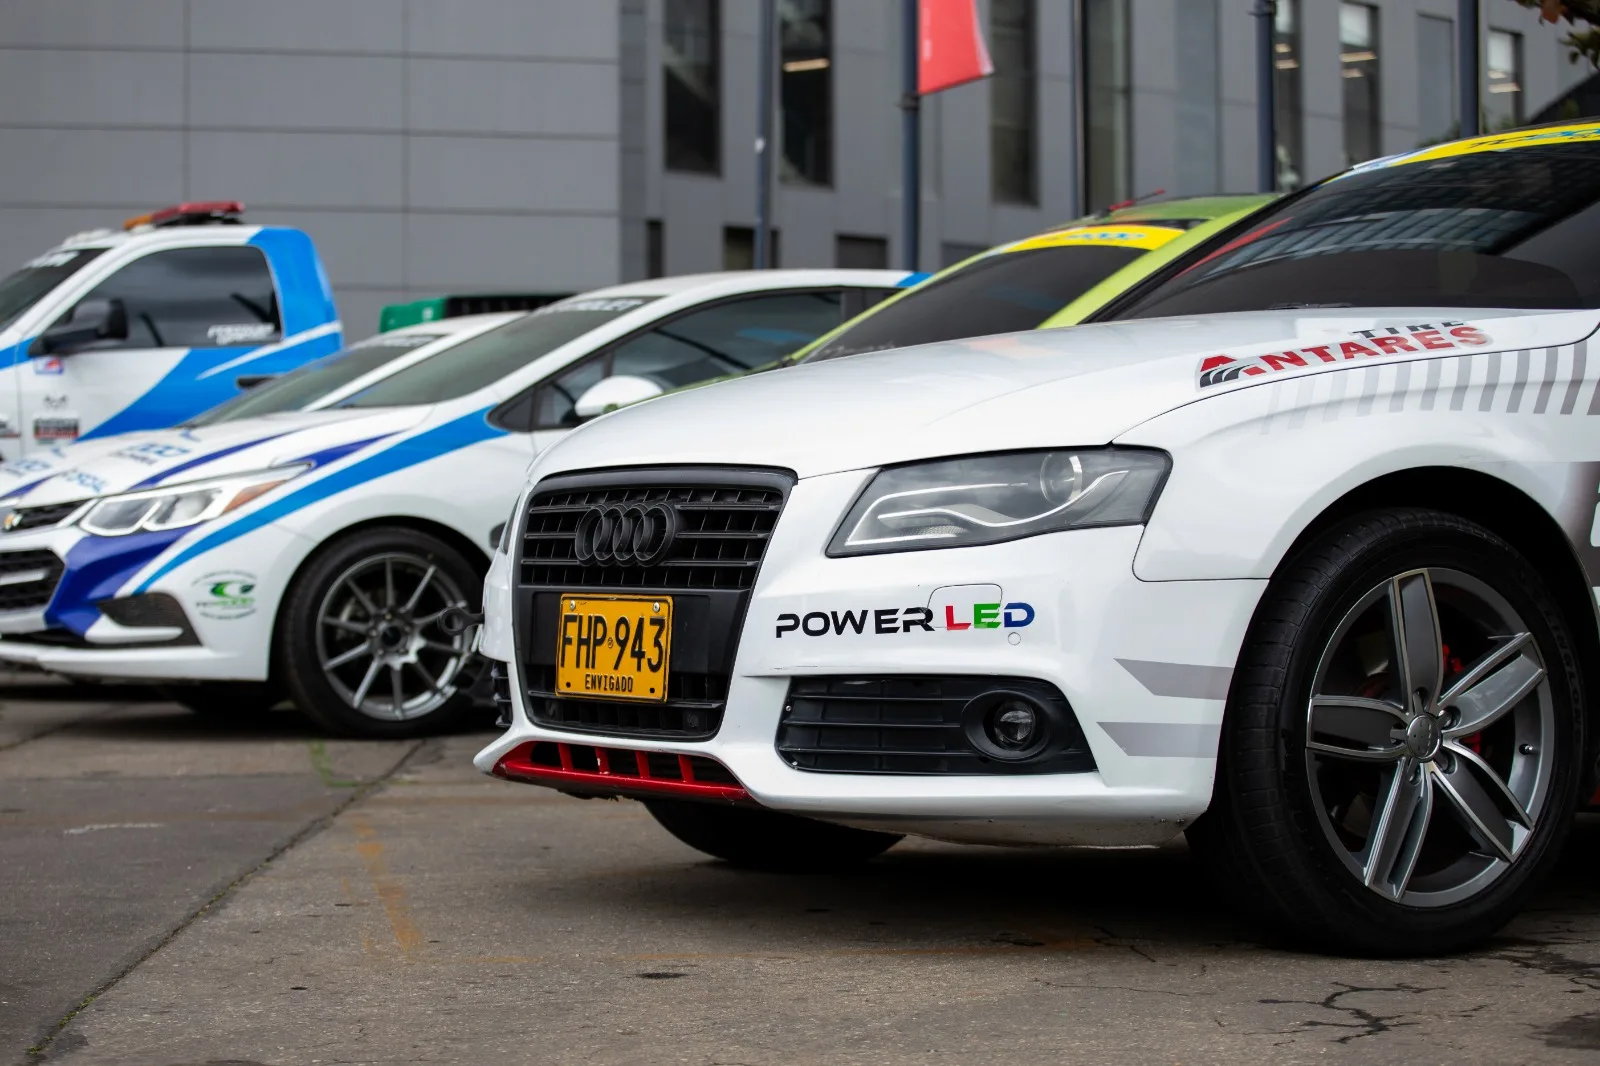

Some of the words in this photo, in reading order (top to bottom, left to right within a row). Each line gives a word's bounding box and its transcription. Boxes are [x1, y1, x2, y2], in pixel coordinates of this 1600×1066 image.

[775, 606, 935, 638] POWER
[945, 602, 1036, 631] LED
[560, 614, 608, 669] FHP
[613, 616, 666, 673] 943
[585, 673, 634, 692] ENVIGADO
